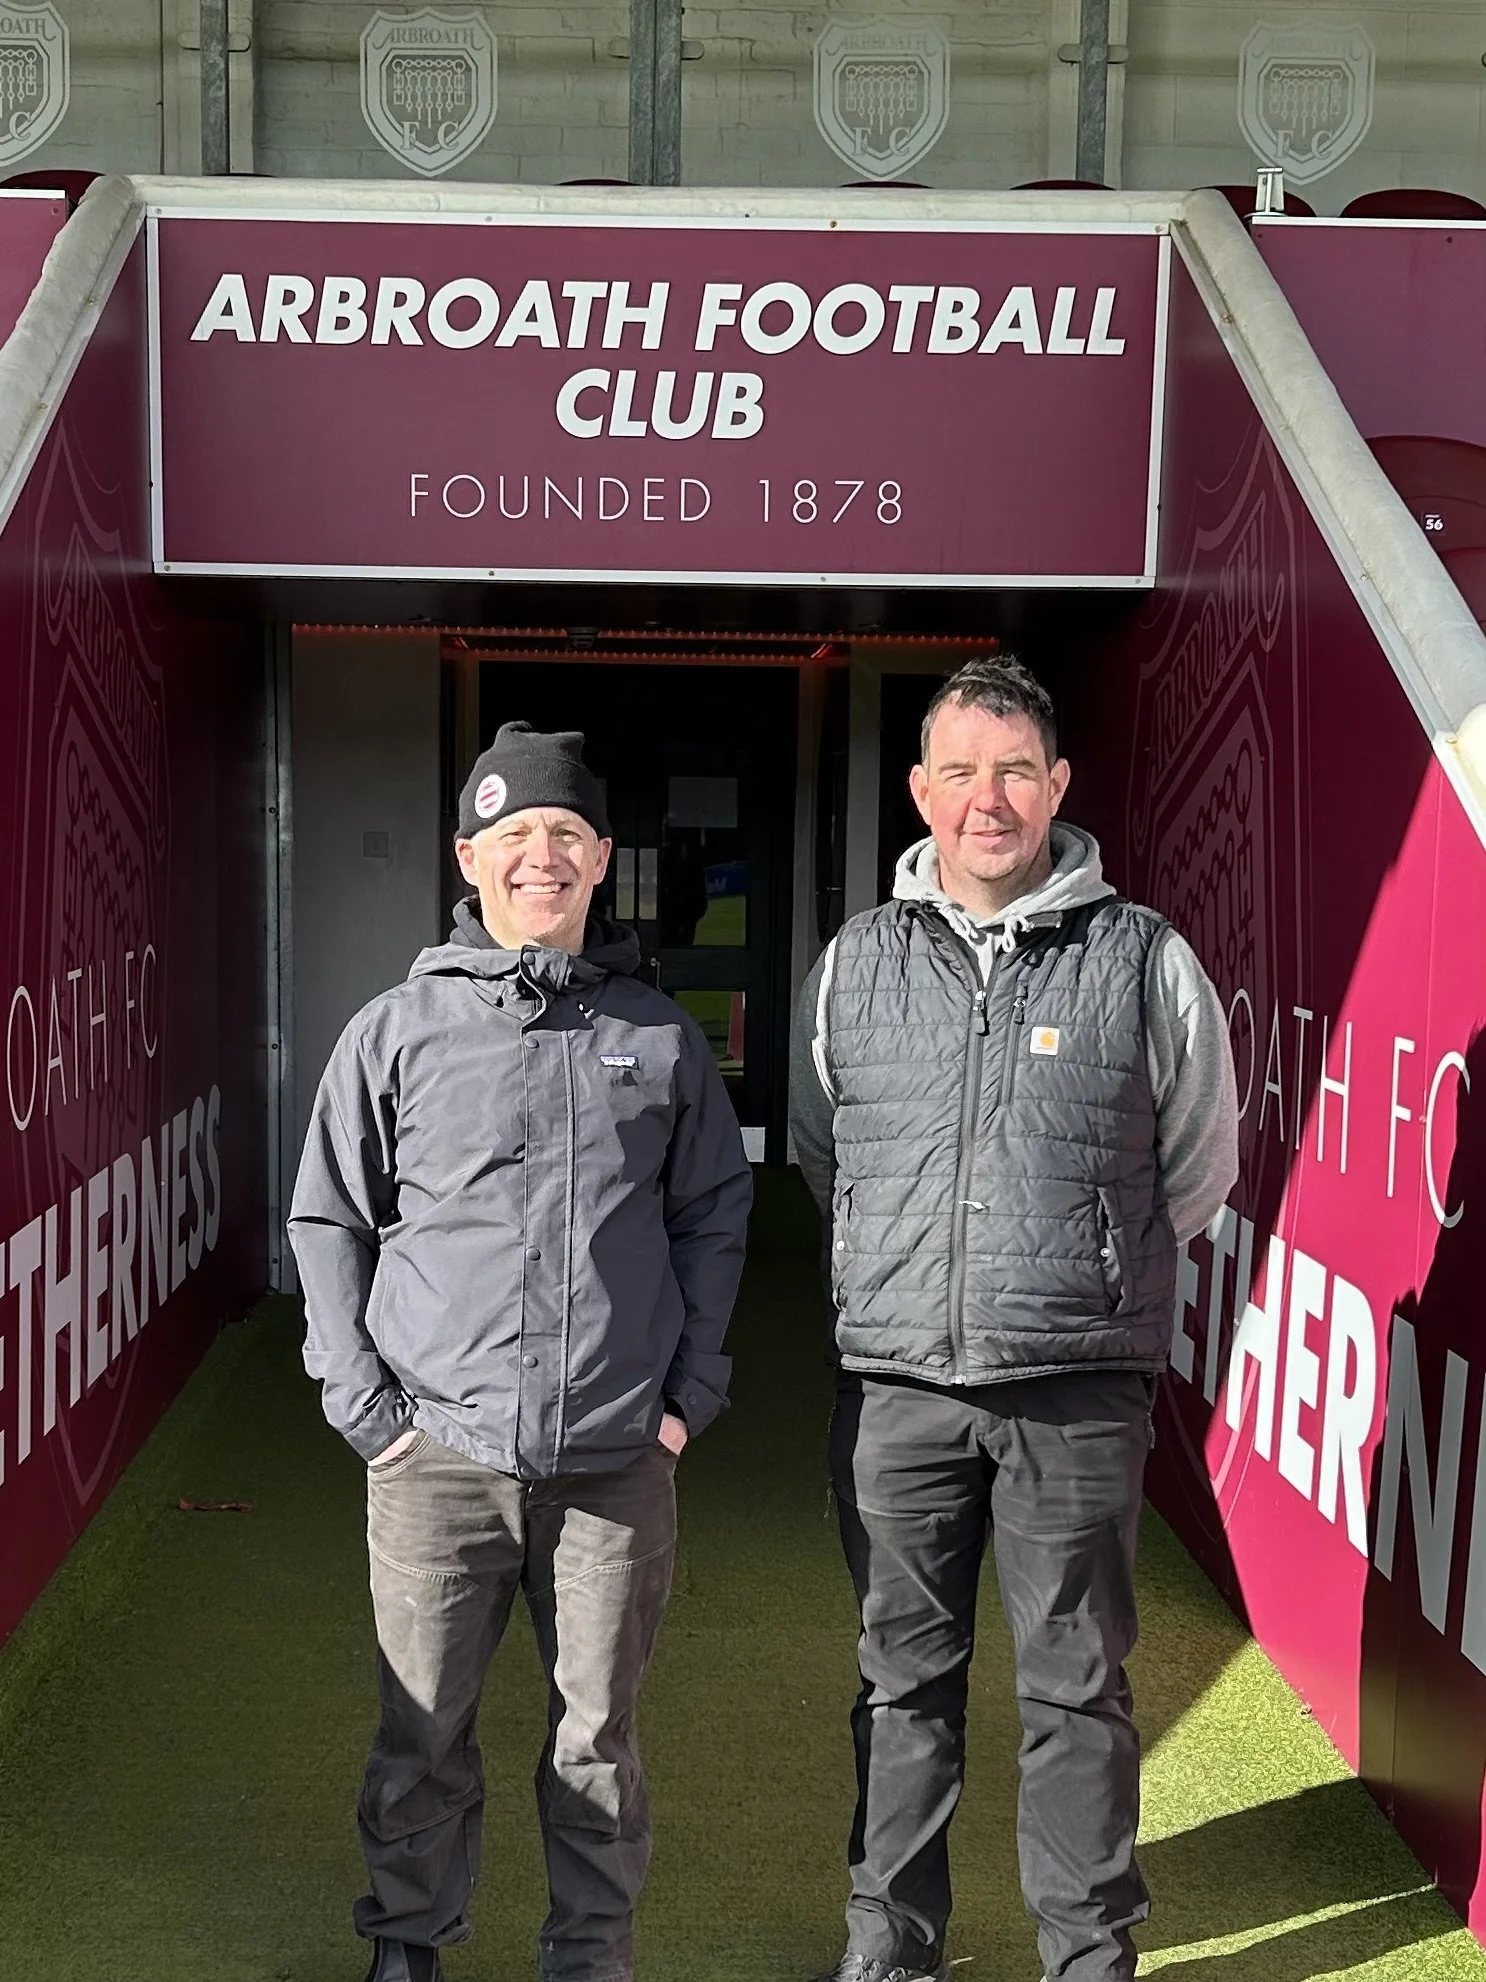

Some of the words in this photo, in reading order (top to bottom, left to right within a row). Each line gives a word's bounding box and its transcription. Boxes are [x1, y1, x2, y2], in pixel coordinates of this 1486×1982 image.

[372, 27, 484, 50] ARBROATH
[190, 273, 670, 349] ARBROATH
[694, 281, 1126, 355] FOOTBALL
[556, 368, 765, 440] CLUB
[410, 473, 711, 522] FOUNDED
[758, 479, 903, 524] 1878
[1425, 518, 1444, 530] 56
[6, 960, 108, 1131] OATH
[125, 943, 158, 1070] FC
[1228, 988, 1352, 1175] OATH
[1387, 1050, 1471, 1229] FC
[0, 1084, 221, 1487] THERNESS
